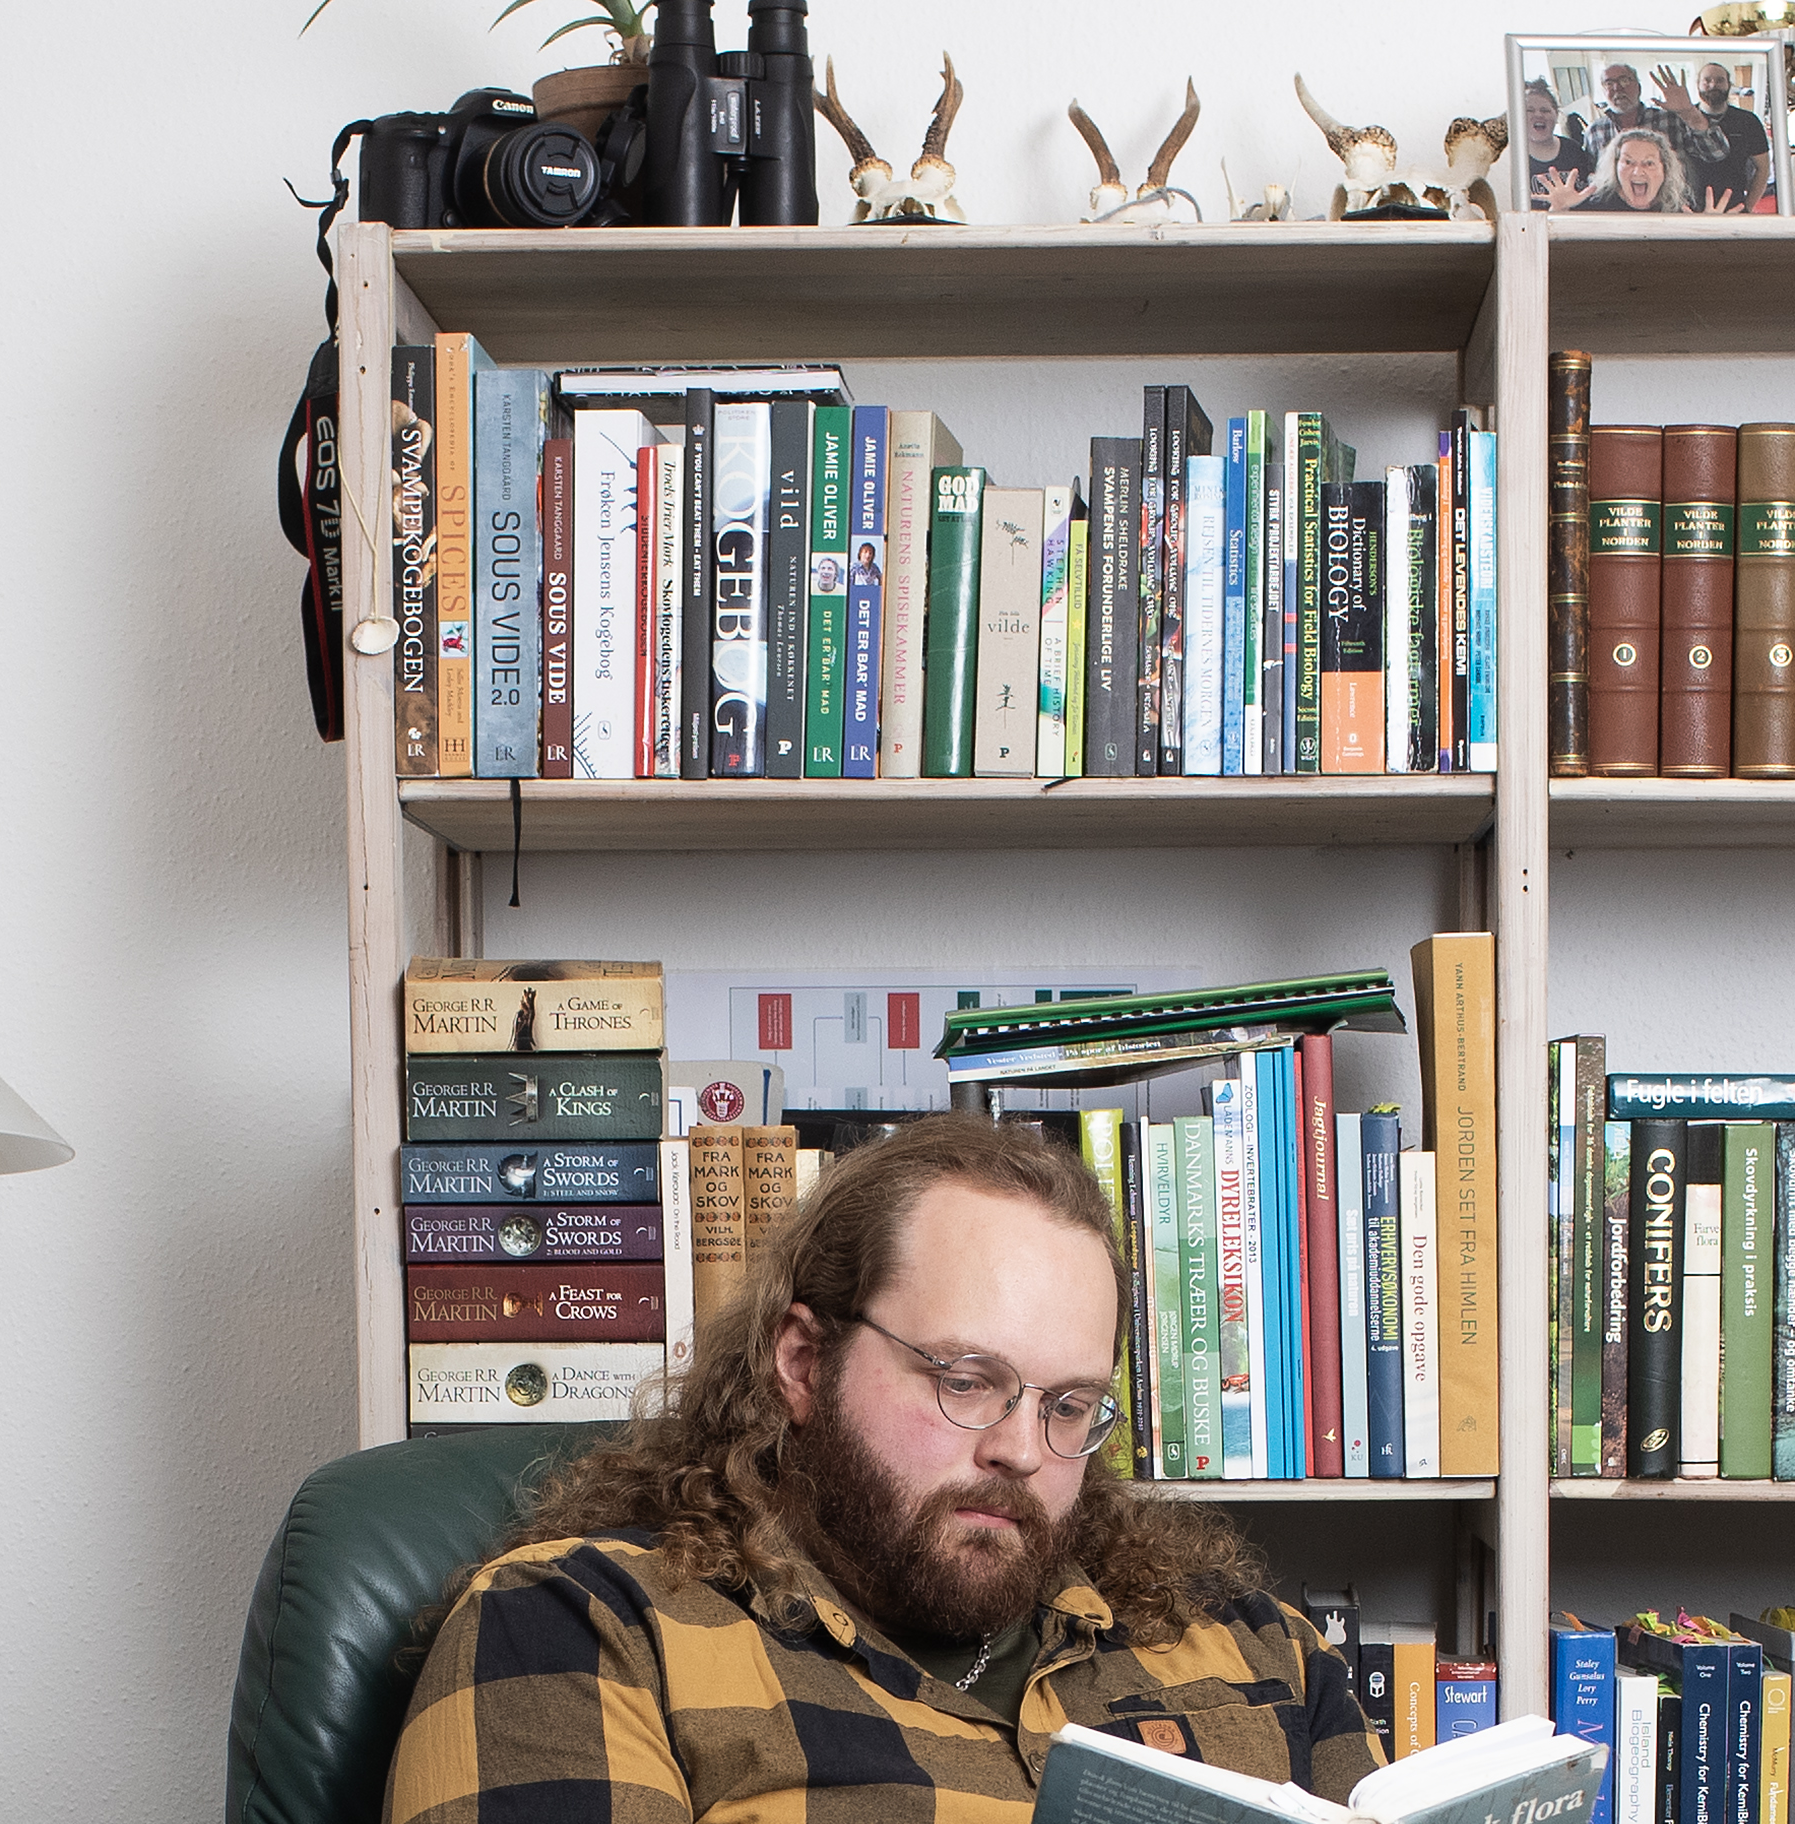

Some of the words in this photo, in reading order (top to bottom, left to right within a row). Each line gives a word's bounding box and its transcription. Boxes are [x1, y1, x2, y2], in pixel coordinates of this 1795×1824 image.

[492, 100, 535, 114] Canon
[316, 416, 335, 490] EOS
[824, 432, 839, 480] JAMIE
[863, 436, 877, 479] JAMIE
[600, 471, 615, 529] Frøken
[780, 470, 800, 529] vild
[862, 481, 876, 530] OLIVER
[938, 475, 978, 494] GOD
[938, 495, 979, 514] MAD
[1104, 468, 1115, 550] SVAMPENES
[1119, 468, 1129, 515] MERLIN
[316, 500, 341, 539] 7D
[823, 483, 838, 540] OLIVER
[900, 471, 913, 566] NATURENS
[1600, 518, 1651, 528] PLANTER
[1609, 507, 1643, 517] VILDE
[402, 429, 423, 694] SVAMPEKOGEBOGEN
[441, 485, 465, 613] SPICES
[492, 511, 520, 602] SOUS
[1118, 520, 1129, 590] SHELDRAKE
[1328, 505, 1349, 623] BIOLOGY
[1602, 537, 1649, 547] NORDEN
[323, 548, 343, 596] Mark
[597, 535, 615, 600] Jensens
[549, 572, 566, 634] SOUS
[1101, 555, 1114, 664] FORUNDERLIGE
[492, 611, 520, 685] VIDE
[594, 606, 615, 680] Kogebog
[894, 576, 909, 706] SPISEKAMMER
[1622, 649, 1628, 659] 1
[491, 689, 519, 705] 2.0
[549, 641, 566, 704] VIDE
[1101, 669, 1112, 691] LIV
[412, 999, 468, 1013] GEORGE
[412, 1014, 497, 1033] MARTIN
[550, 1013, 631, 1030] THRONES
[568, 997, 608, 1012] GAME
[556, 1099, 611, 1117] KINGS
[560, 1082, 604, 1097] CLASH
[1626, 1080, 1684, 1109] Fugle
[1691, 1081, 1697, 1103] i
[1703, 1079, 1763, 1106] felten
[703, 1152, 731, 1162] FRA
[1313, 1096, 1329, 1200] Jagtjournal
[1458, 1106, 1474, 1183] JORDEN
[695, 1166, 740, 1178] MARK
[706, 1182, 727, 1192] OG
[1157, 1143, 1170, 1225] HVIRVELDYR
[1183, 1123, 1204, 1248] DANMARKS
[697, 1196, 740, 1208] SKOV
[1459, 1189, 1475, 1225] SET
[1742, 1148, 1758, 1250] Skovdyrkning
[1221, 1170, 1243, 1322] DYRELEKSIKON
[1413, 1235, 1427, 1268] Den
[1459, 1230, 1476, 1268] FRA
[1644, 1149, 1675, 1333] CONIFERS
[1189, 1254, 1206, 1334] TRÆER
[1410, 1276, 1424, 1315] gode
[1606, 1217, 1630, 1343] Jordforbedring
[1742, 1263, 1756, 1317] praksis
[1459, 1273, 1477, 1346] HIMLEN
[1192, 1337, 1207, 1370] OG
[1410, 1320, 1426, 1382] opgave
[1193, 1378, 1211, 1445] BUSKE
[1444, 1686, 1487, 1704] Stewart
